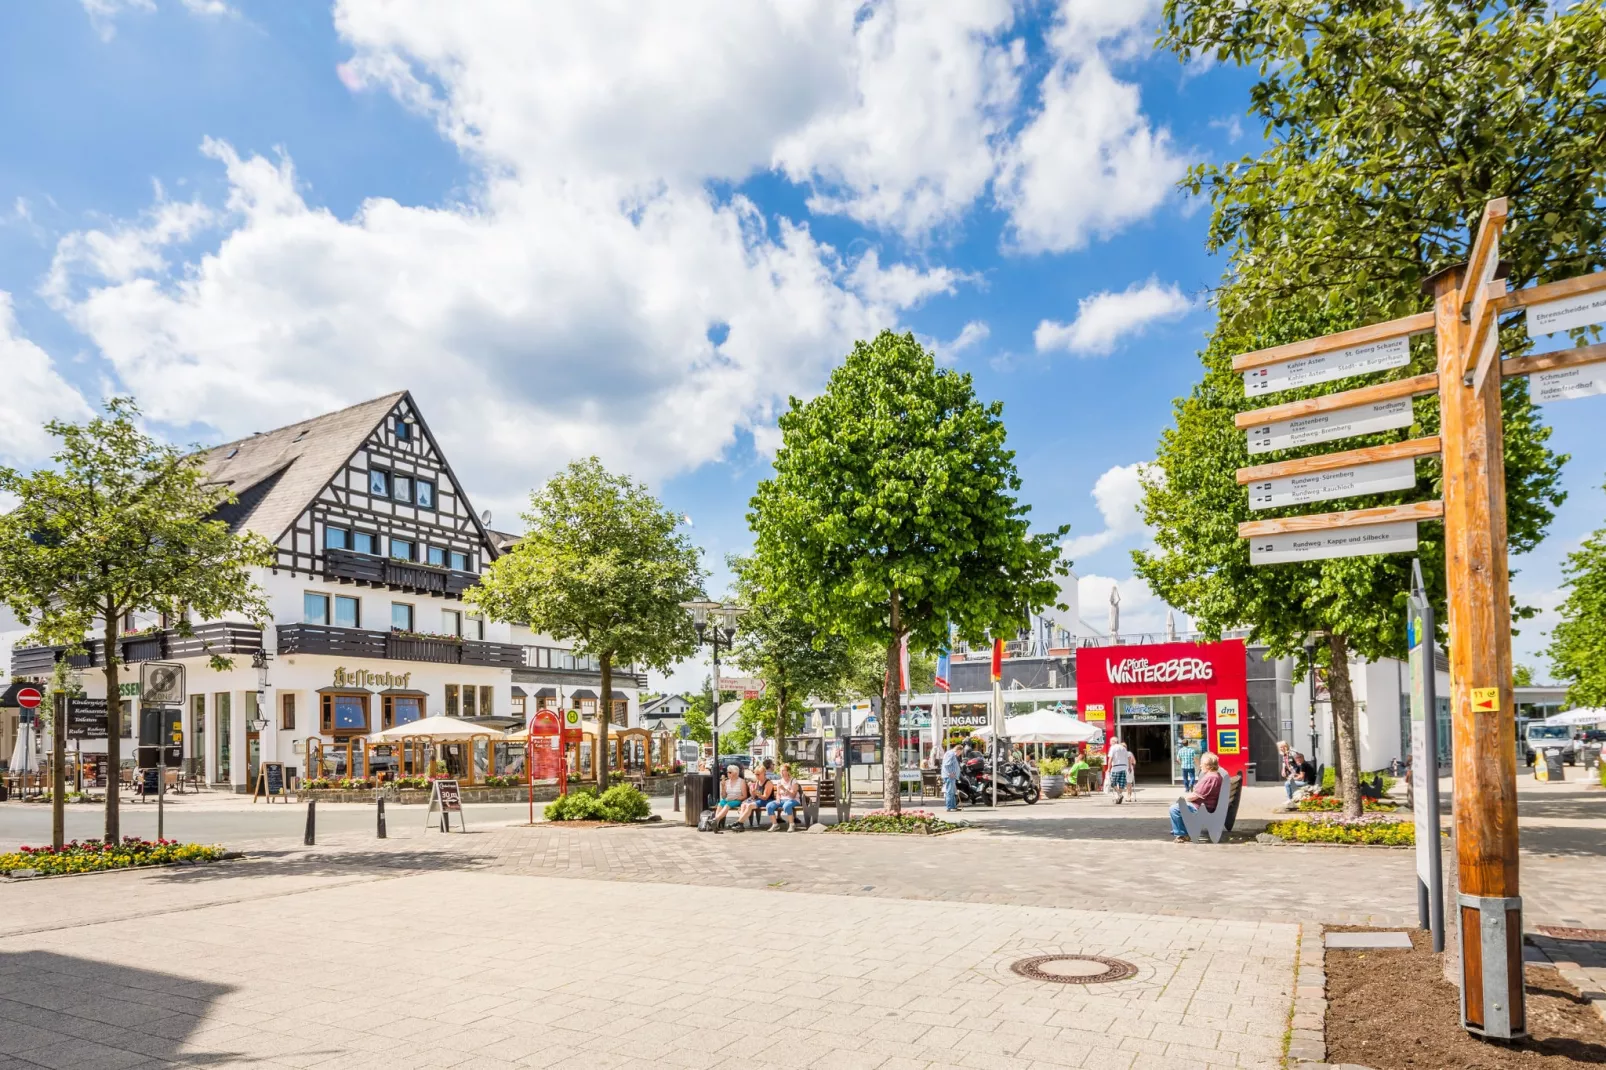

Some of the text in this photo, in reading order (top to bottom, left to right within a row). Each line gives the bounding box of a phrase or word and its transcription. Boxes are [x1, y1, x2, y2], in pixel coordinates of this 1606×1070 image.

[1355, 347, 1375, 356] Georg
[1376, 340, 1403, 351] Schanze
[1307, 357, 1326, 366] Asten
[1539, 369, 1580, 381] Schmantel
[1373, 401, 1406, 412] Nordhang
[1289, 416, 1329, 428] Altastenberg
[1293, 539, 1322, 548] Rundweg
[1327, 537, 1347, 546] Kappe
[1362, 534, 1390, 542] Silbecke
[1127, 658, 1149, 670] Pforte
[1221, 706, 1235, 714] dm
[942, 716, 987, 725] EINGANG
